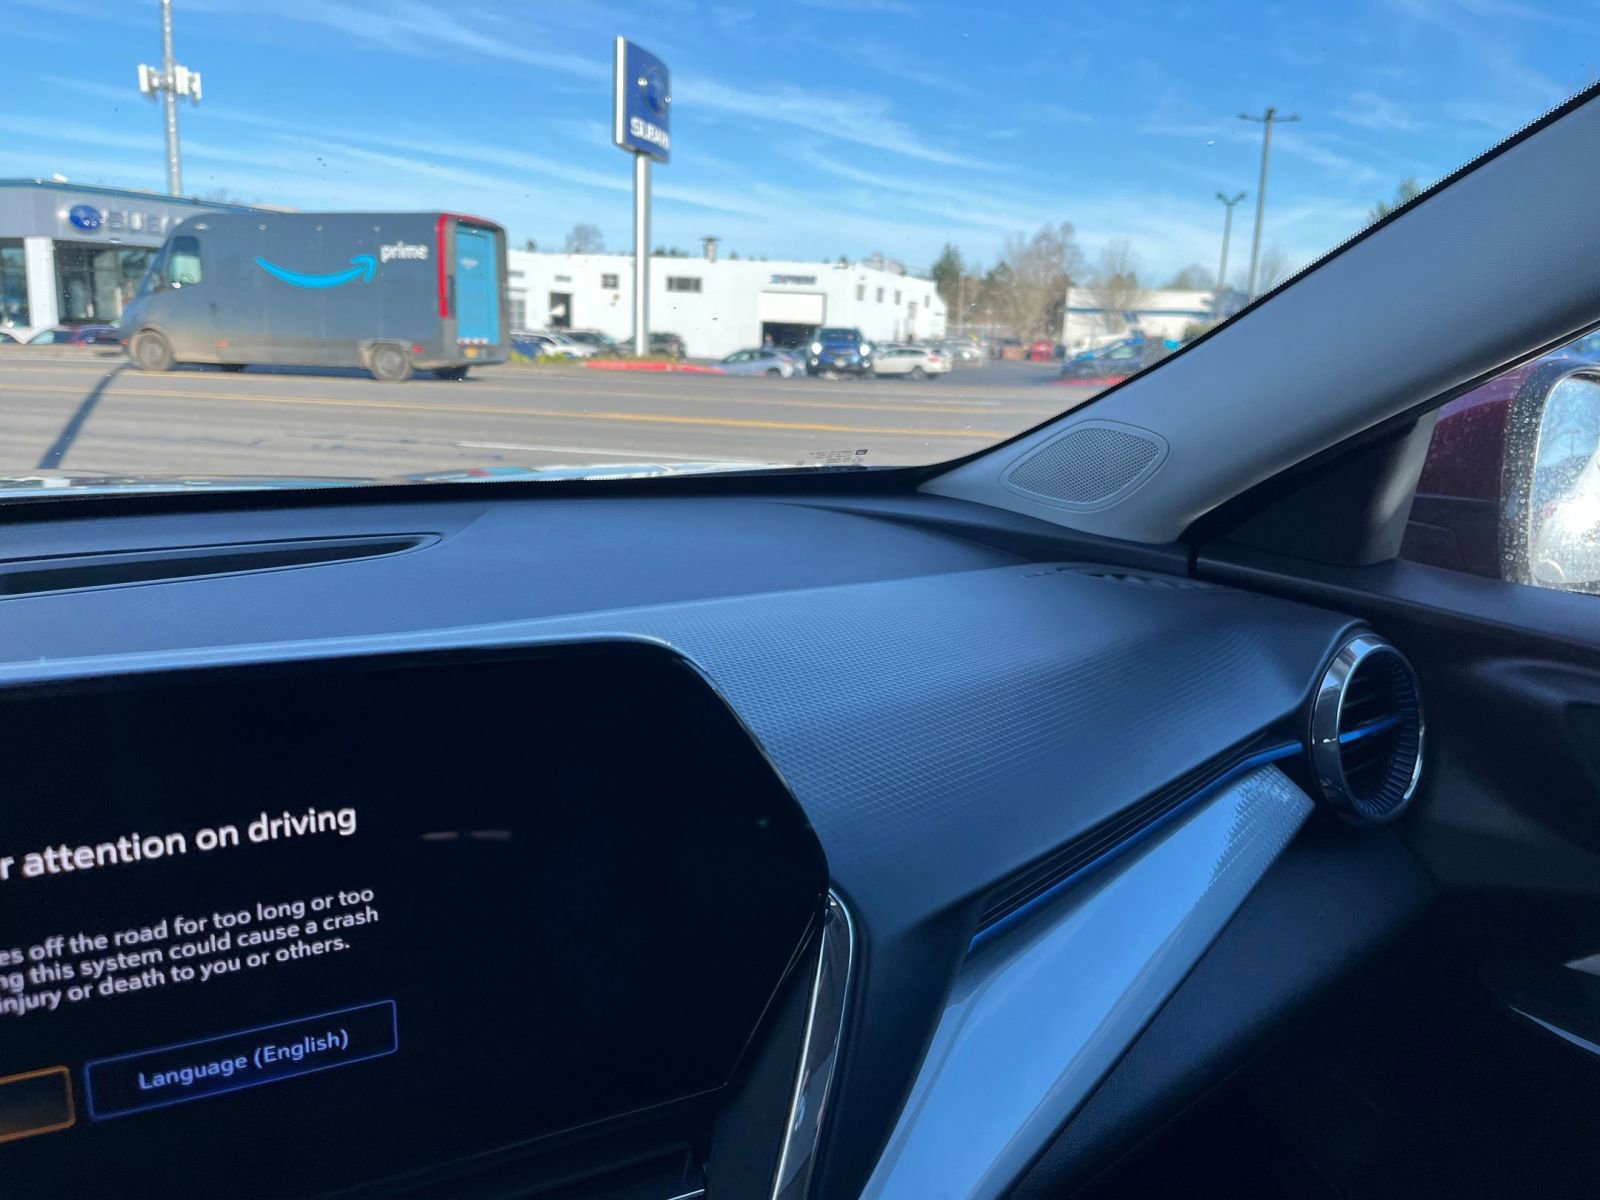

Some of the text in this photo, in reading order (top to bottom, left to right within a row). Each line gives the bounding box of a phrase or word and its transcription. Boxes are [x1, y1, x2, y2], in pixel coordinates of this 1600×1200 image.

[380, 241, 428, 263] prime
[0, 807, 357, 880] r attention on driving
[28, 935, 65, 961] off
[69, 931, 109, 954] the
[114, 920, 168, 947] road
[173, 914, 208, 936] for
[213, 910, 251, 929] too
[256, 901, 305, 921] long
[311, 895, 334, 911] or
[338, 888, 375, 907] too
[30, 962, 75, 985] this
[80, 947, 163, 979] system
[169, 931, 232, 960] could
[236, 923, 300, 947] cause
[304, 920, 318, 935] a
[322, 905, 379, 931] crash
[67, 984, 94, 1002] or
[98, 966, 166, 997] death
[170, 964, 196, 983] to
[200, 956, 242, 982] you
[246, 951, 271, 968] or
[275, 937, 351, 963] others.
[138, 1029, 349, 1091] Language (English)
